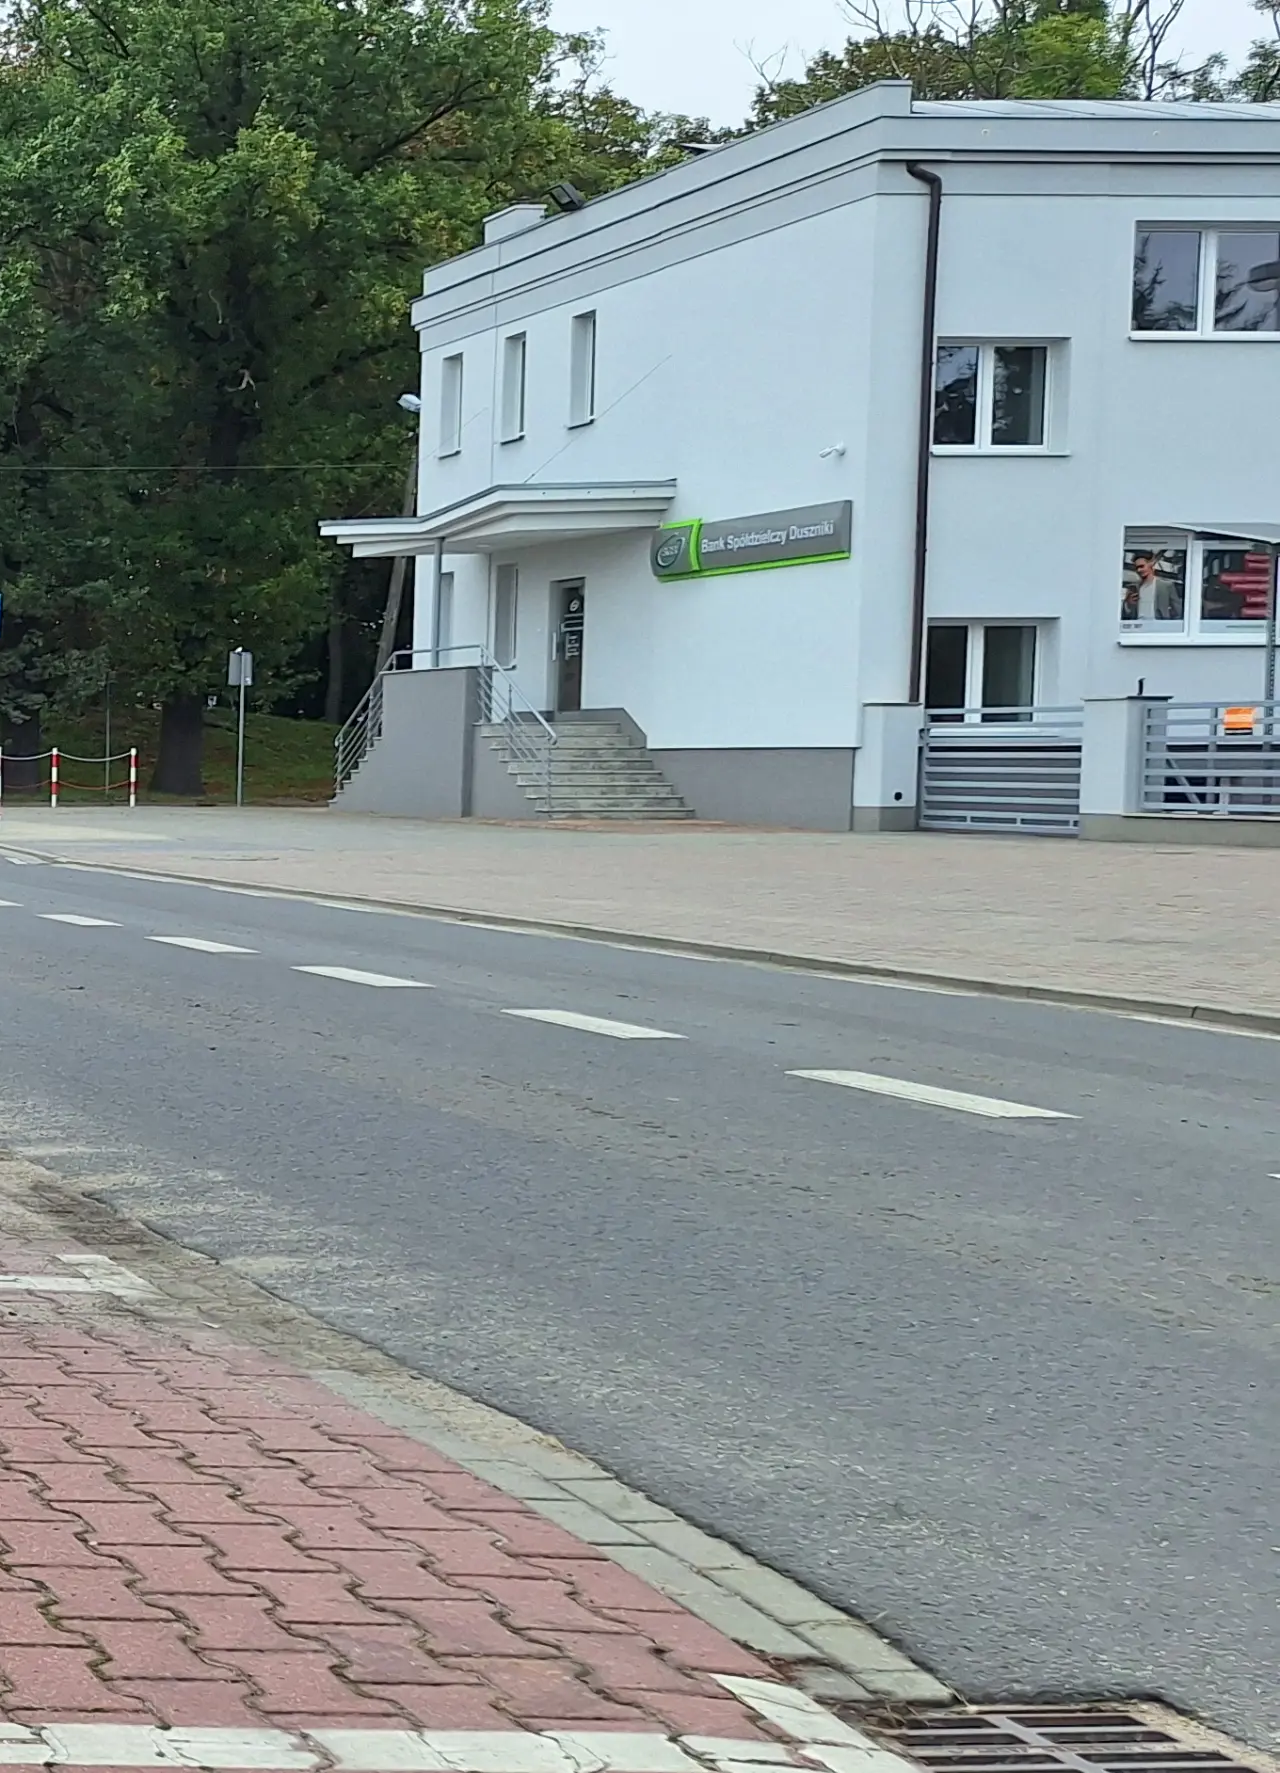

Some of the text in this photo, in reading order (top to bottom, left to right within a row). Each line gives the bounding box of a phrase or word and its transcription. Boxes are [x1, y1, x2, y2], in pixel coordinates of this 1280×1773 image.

[701, 538, 725, 553] Bank
[727, 529, 787, 551] Spółdzielczy
[790, 520, 834, 541] Duszniki
